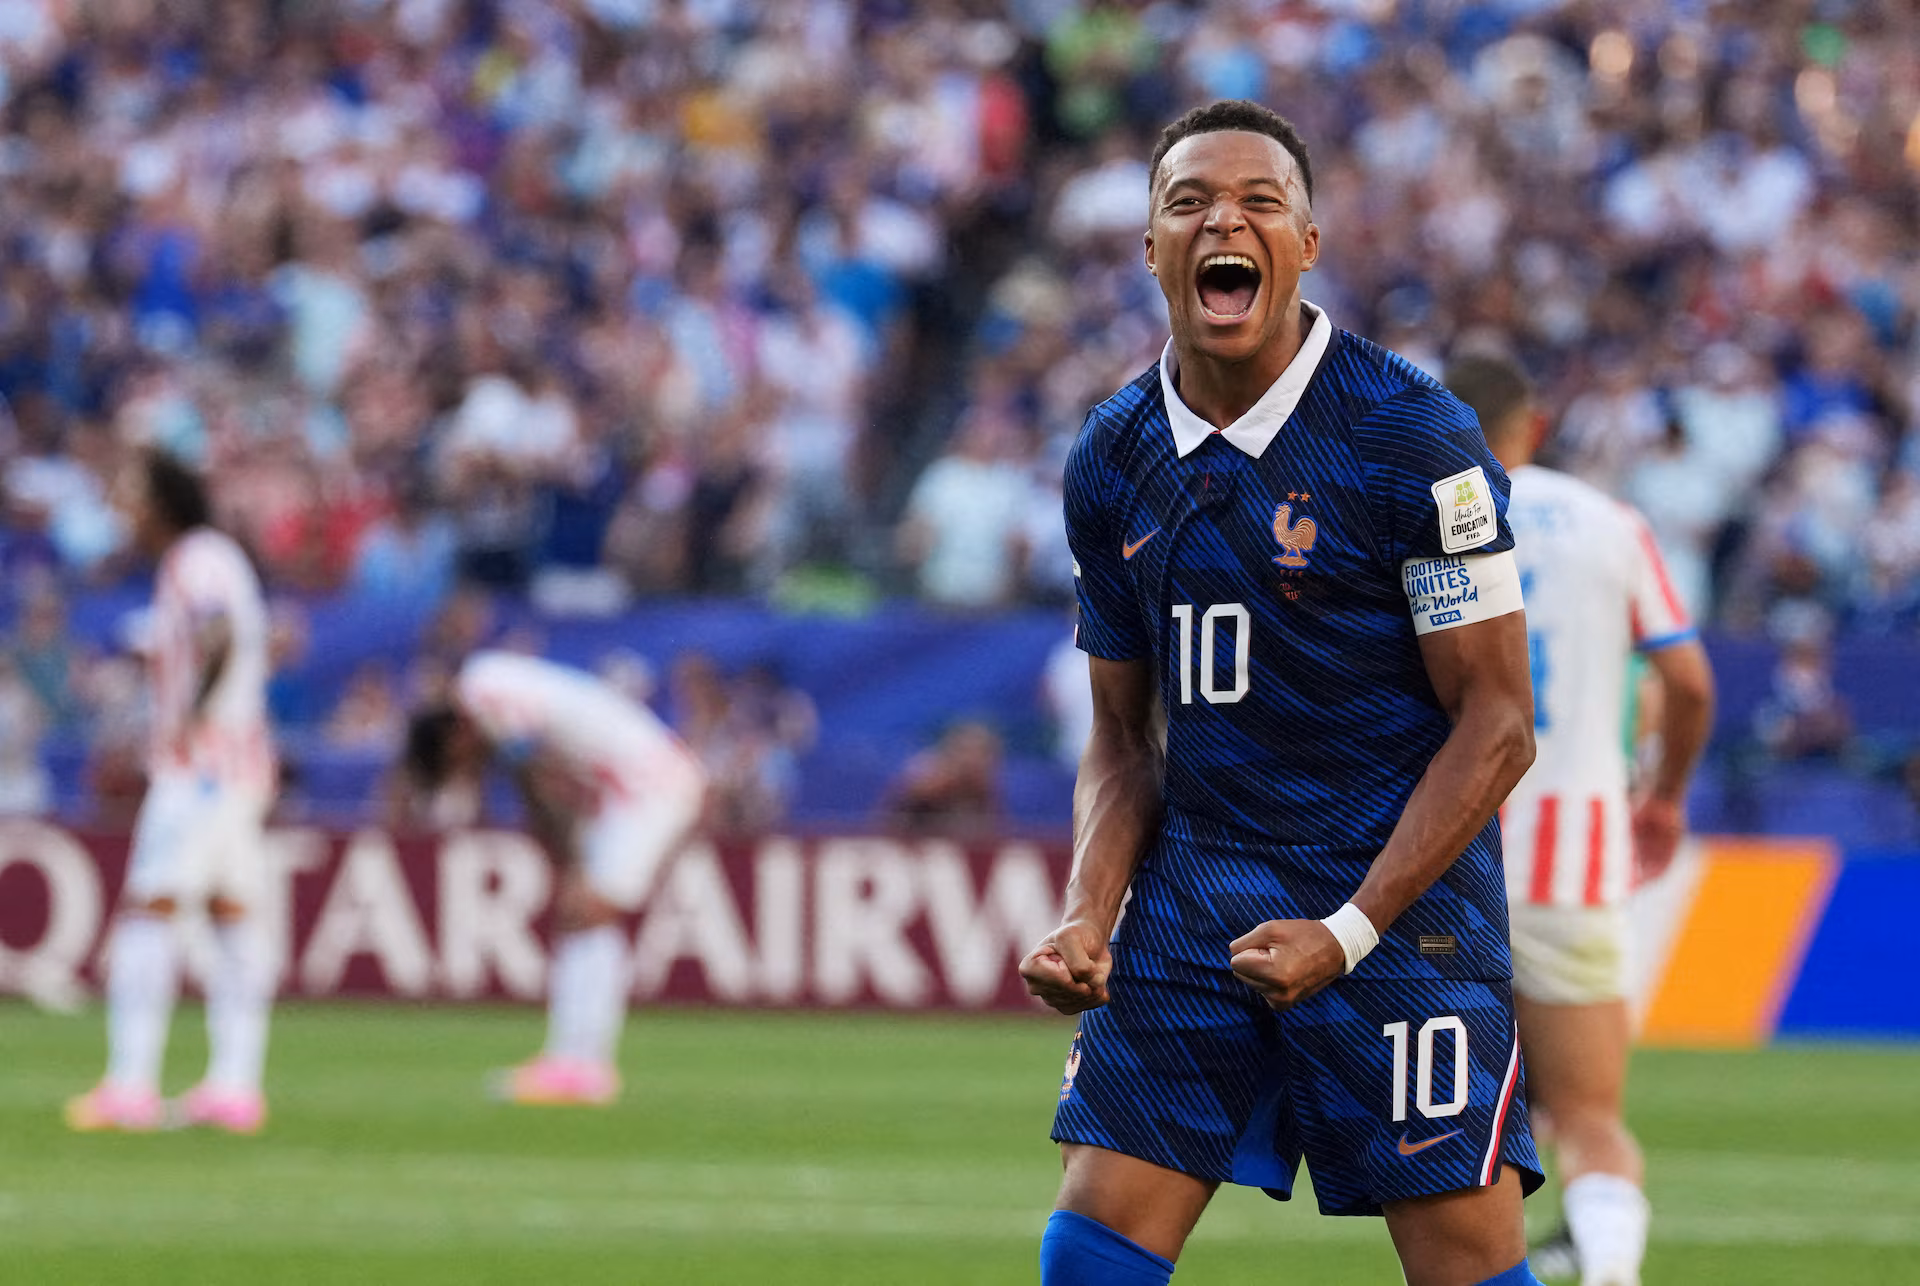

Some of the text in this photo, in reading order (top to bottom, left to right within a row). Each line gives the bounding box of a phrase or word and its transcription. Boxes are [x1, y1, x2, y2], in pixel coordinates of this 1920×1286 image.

[1451, 515, 1488, 536] EDUCATION
[1466, 531, 1481, 541] FIFA
[1405, 556, 1466, 579] FOOTBALL
[1407, 567, 1471, 598] UNITES
[1411, 586, 1479, 616] the World
[1432, 612, 1461, 624] FIFA
[1171, 602, 1251, 705] 10
[1383, 1015, 1469, 1122] 10
